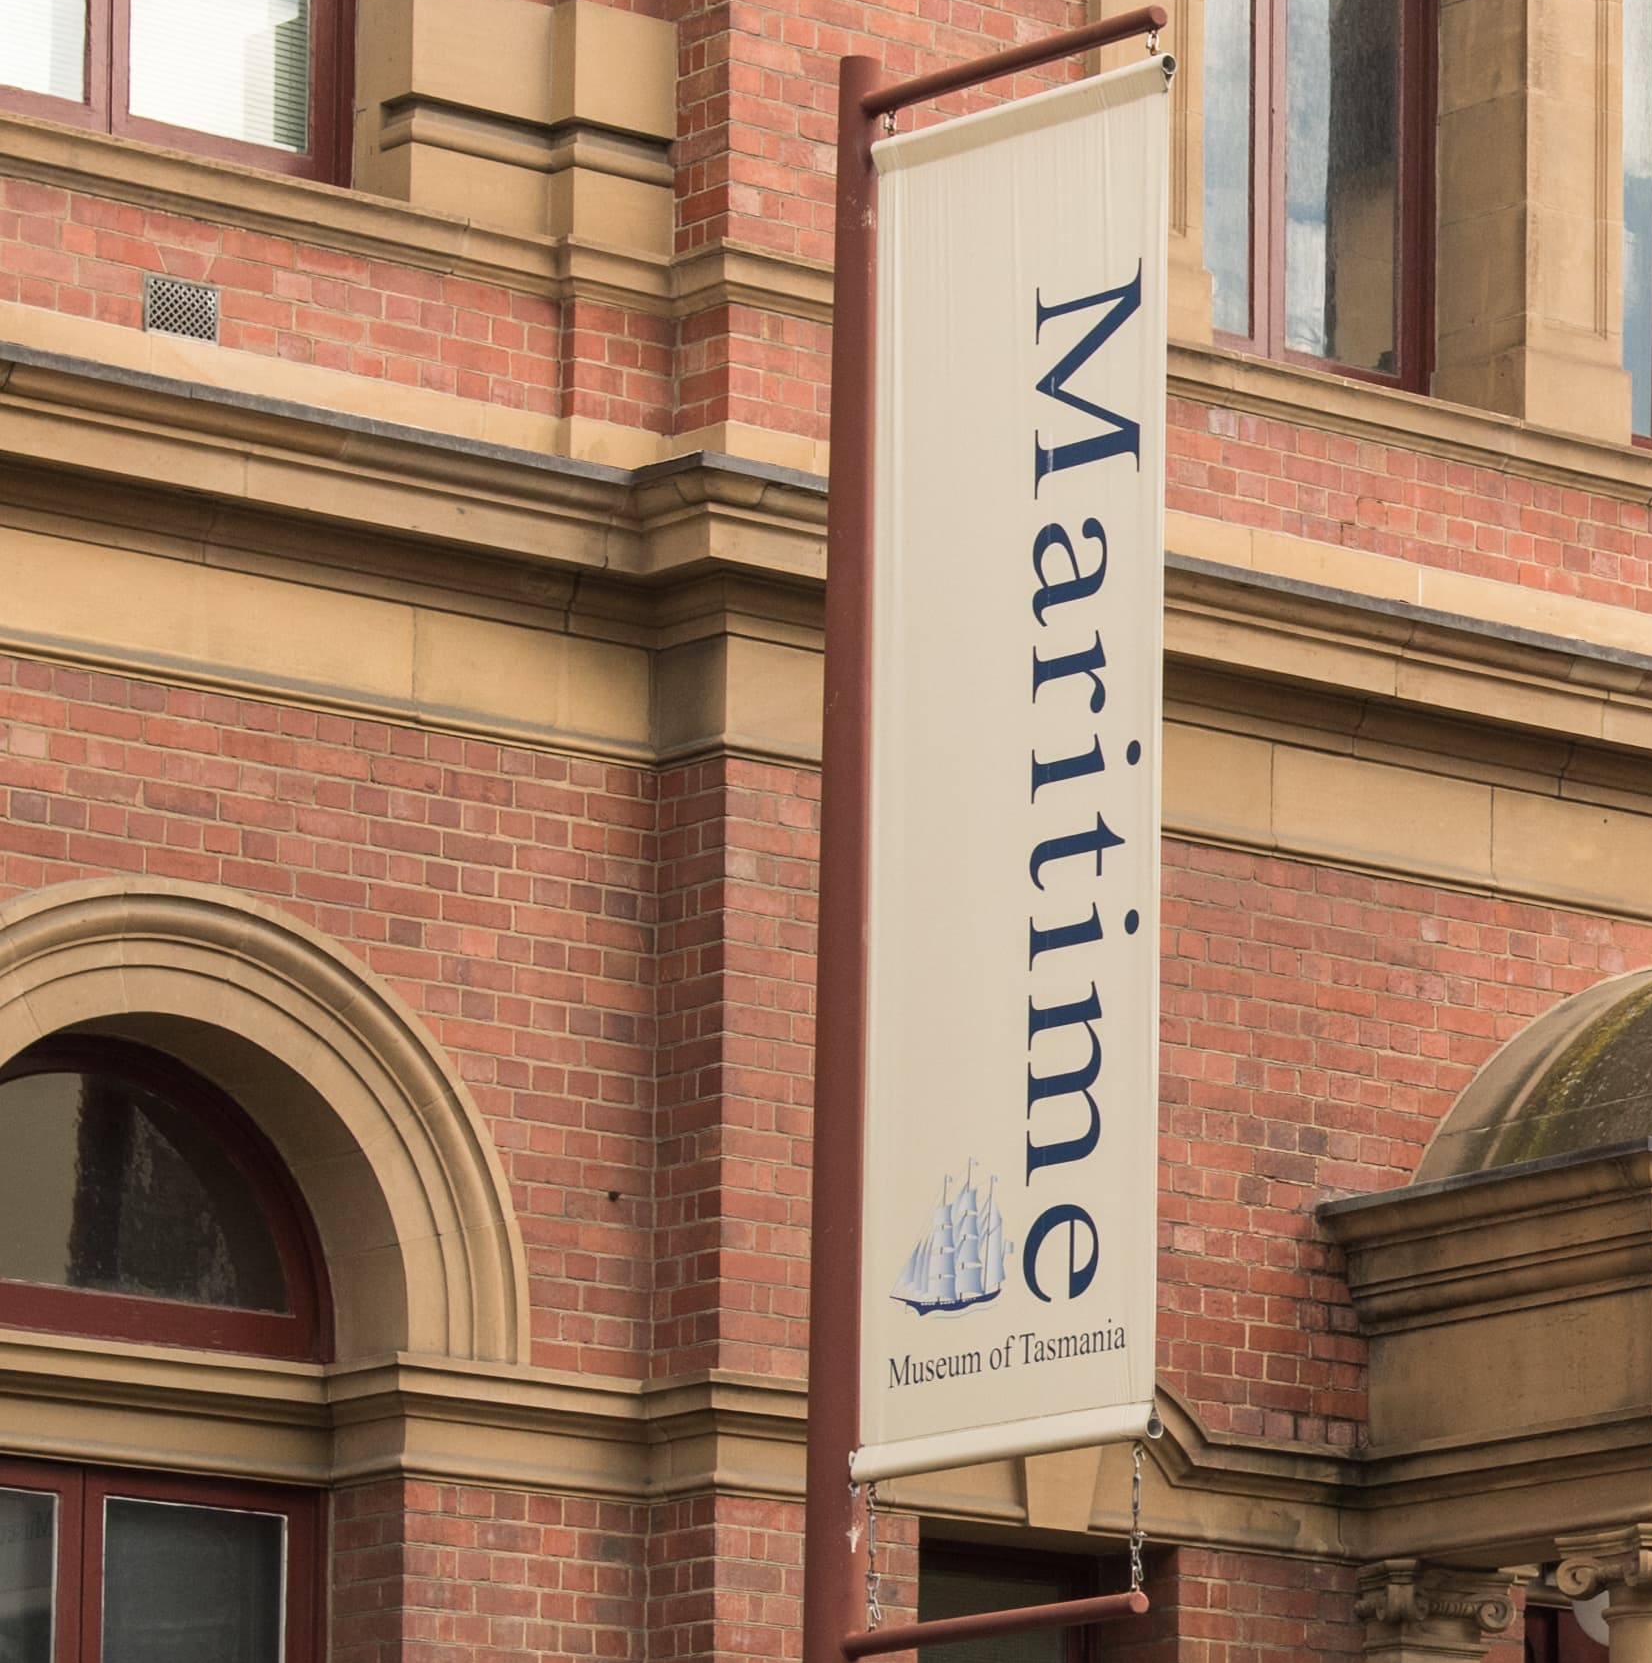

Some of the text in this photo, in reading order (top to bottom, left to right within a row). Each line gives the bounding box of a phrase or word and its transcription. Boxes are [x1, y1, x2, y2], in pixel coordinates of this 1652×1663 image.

[1023, 257, 1142, 1304] Maritime
[887, 1318, 1126, 1389] Museum of Tasmania
